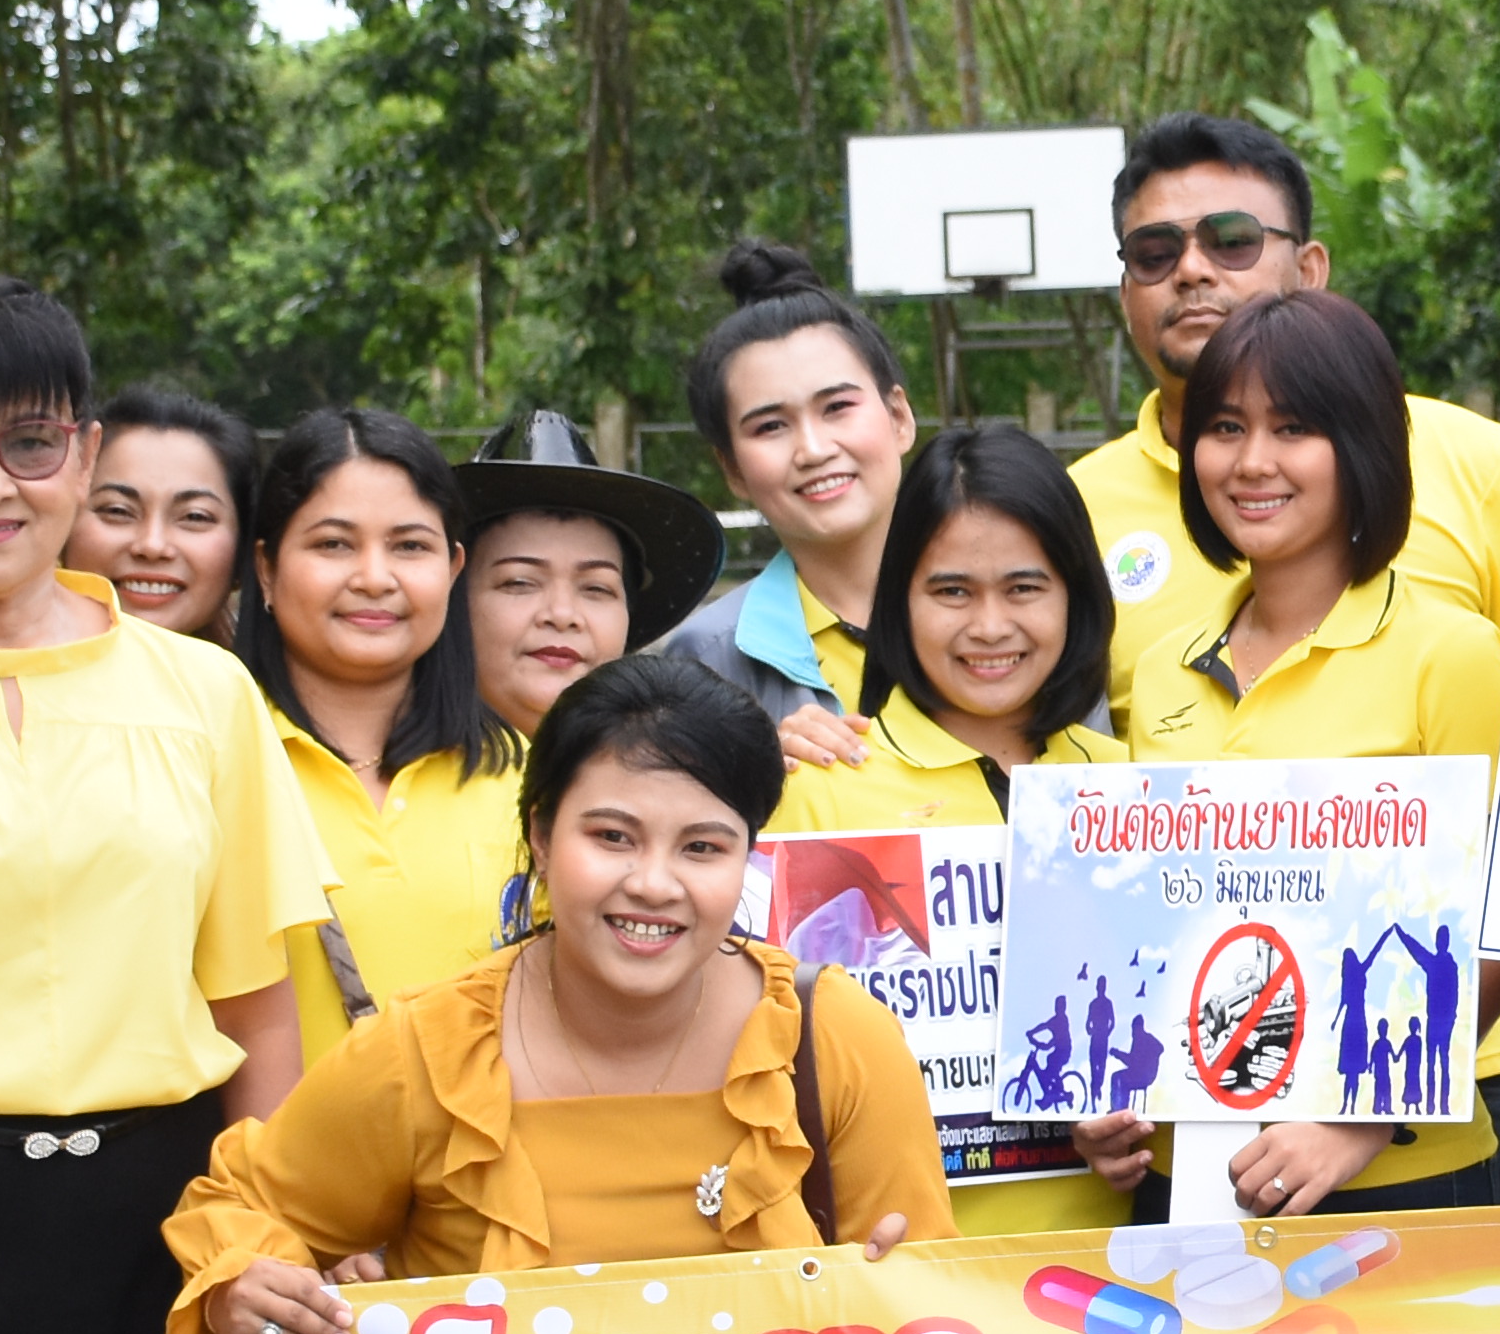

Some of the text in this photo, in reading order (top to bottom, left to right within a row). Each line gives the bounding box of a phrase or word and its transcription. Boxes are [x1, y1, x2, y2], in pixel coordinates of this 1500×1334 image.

[1070, 779, 1427, 853] วันต่อต้านยาเสพติด
[1215, 859, 1325, 919] มิถุนายน
